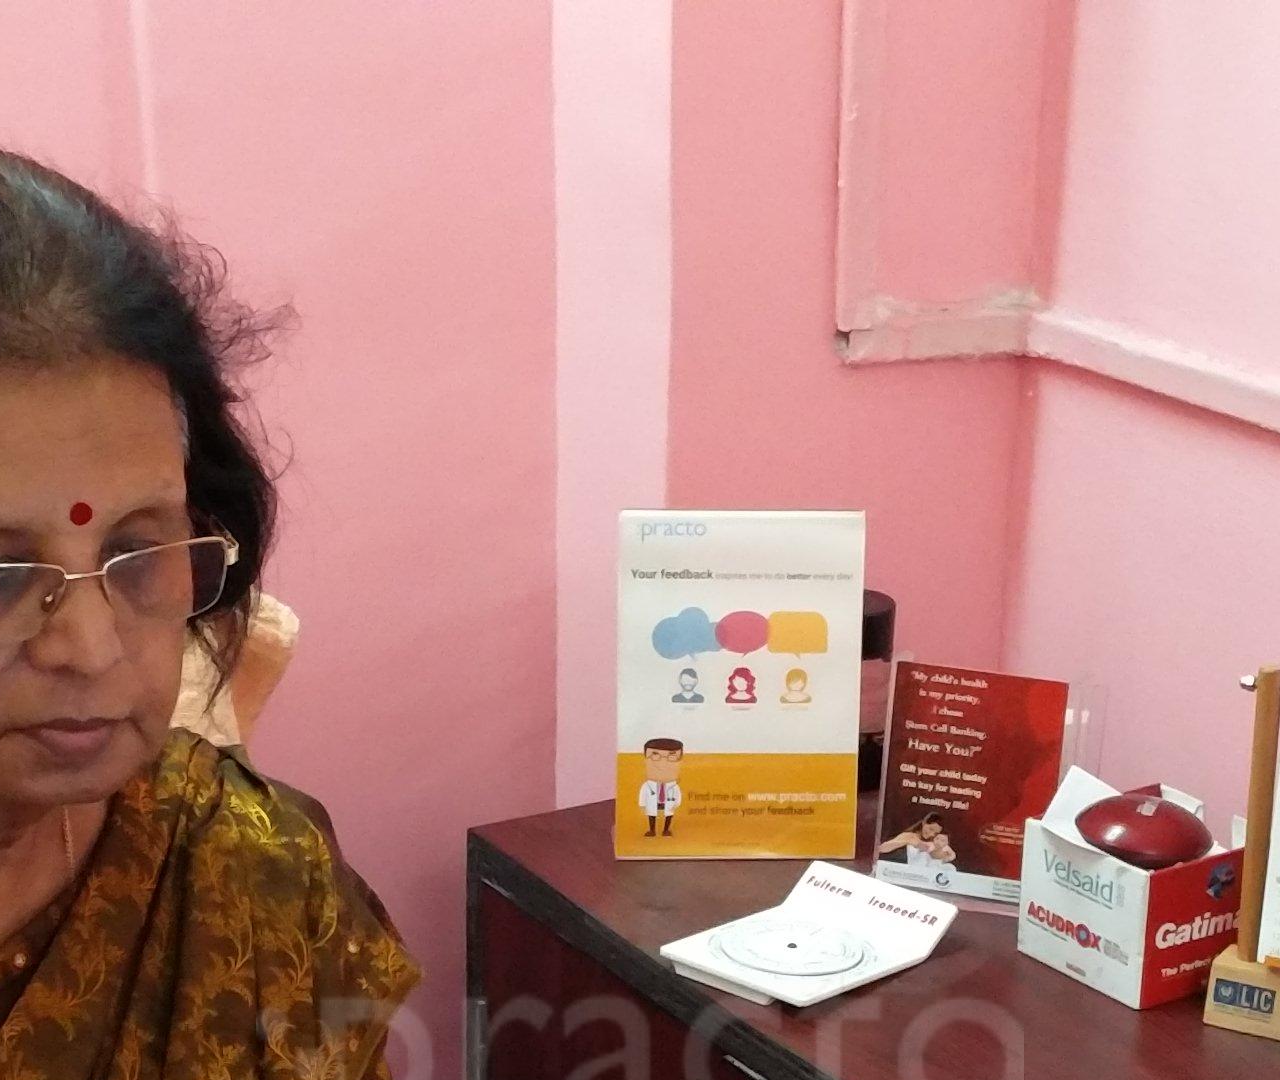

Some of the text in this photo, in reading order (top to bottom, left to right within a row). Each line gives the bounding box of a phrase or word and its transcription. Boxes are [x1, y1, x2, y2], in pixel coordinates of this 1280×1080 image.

[641, 522, 706, 545] practo
[631, 569, 657, 580] Your
[661, 569, 713, 580] feedback
[960, 677, 988, 688] health
[929, 691, 942, 700] my
[907, 737, 940, 753] Have
[900, 763, 988, 785] Gift your child today
[902, 779, 917, 788] the
[918, 781, 934, 793] key
[935, 783, 948, 793] for
[688, 791, 710, 801] Find
[713, 793, 730, 801] me
[732, 793, 745, 801] on
[919, 795, 951, 809] healthy
[741, 806, 765, 817] your
[767, 805, 815, 816] feedback
[1043, 849, 1114, 904] Velsaid
[806, 875, 853, 899] Fulterm
[1027, 901, 1102, 953] ACUDROX
[1240, 983, 1275, 1014] LIC
